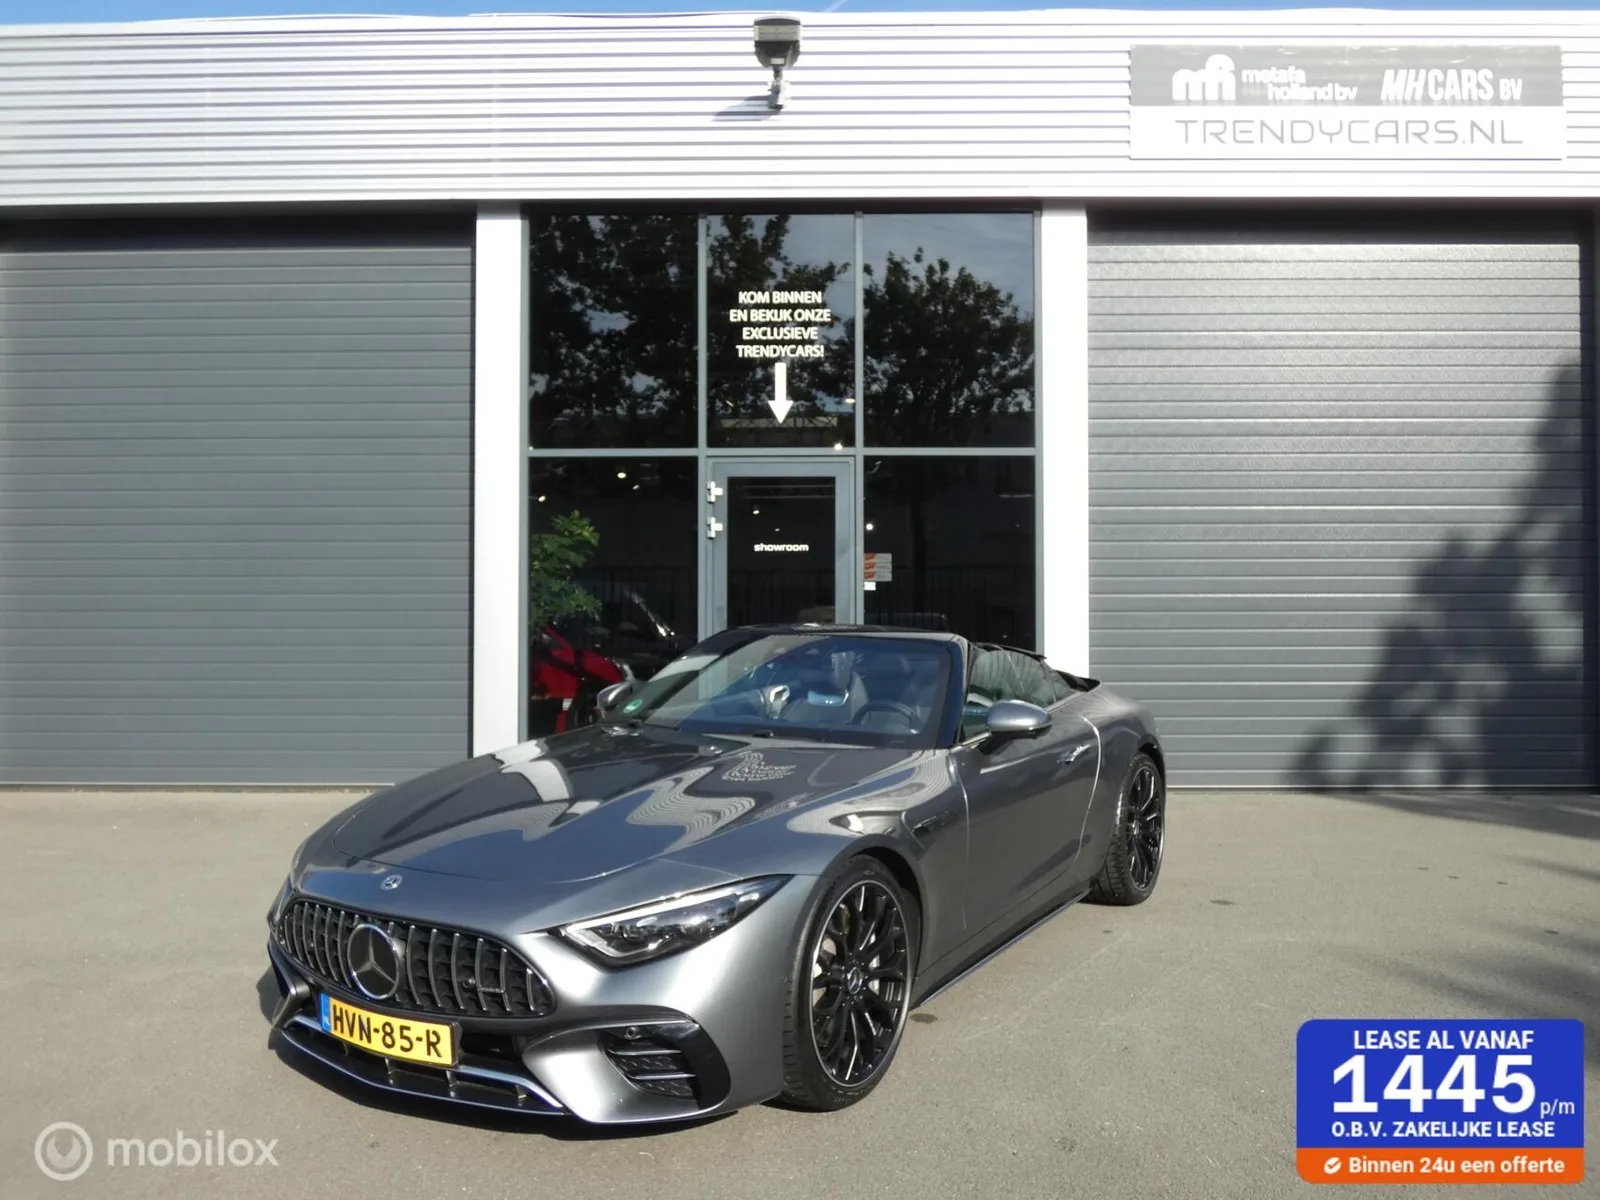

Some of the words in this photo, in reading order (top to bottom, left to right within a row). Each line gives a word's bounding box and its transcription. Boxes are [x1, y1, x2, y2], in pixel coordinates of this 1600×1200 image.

[1499, 78, 1523, 100] BV
[1175, 119, 1524, 145] TRENDYCARS.NL
[738, 291, 770, 304] KOM
[772, 291, 822, 304] BINNEN
[729, 309, 748, 322] EN
[750, 309, 792, 322] BEKIJK
[793, 309, 831, 322] ONZE
[742, 327, 818, 340] EXCLUSIEVE
[735, 345, 825, 358] TRENDYCARS!
[754, 543, 809, 552] showroom
[332, 1004, 442, 1058] HVN-85-R
